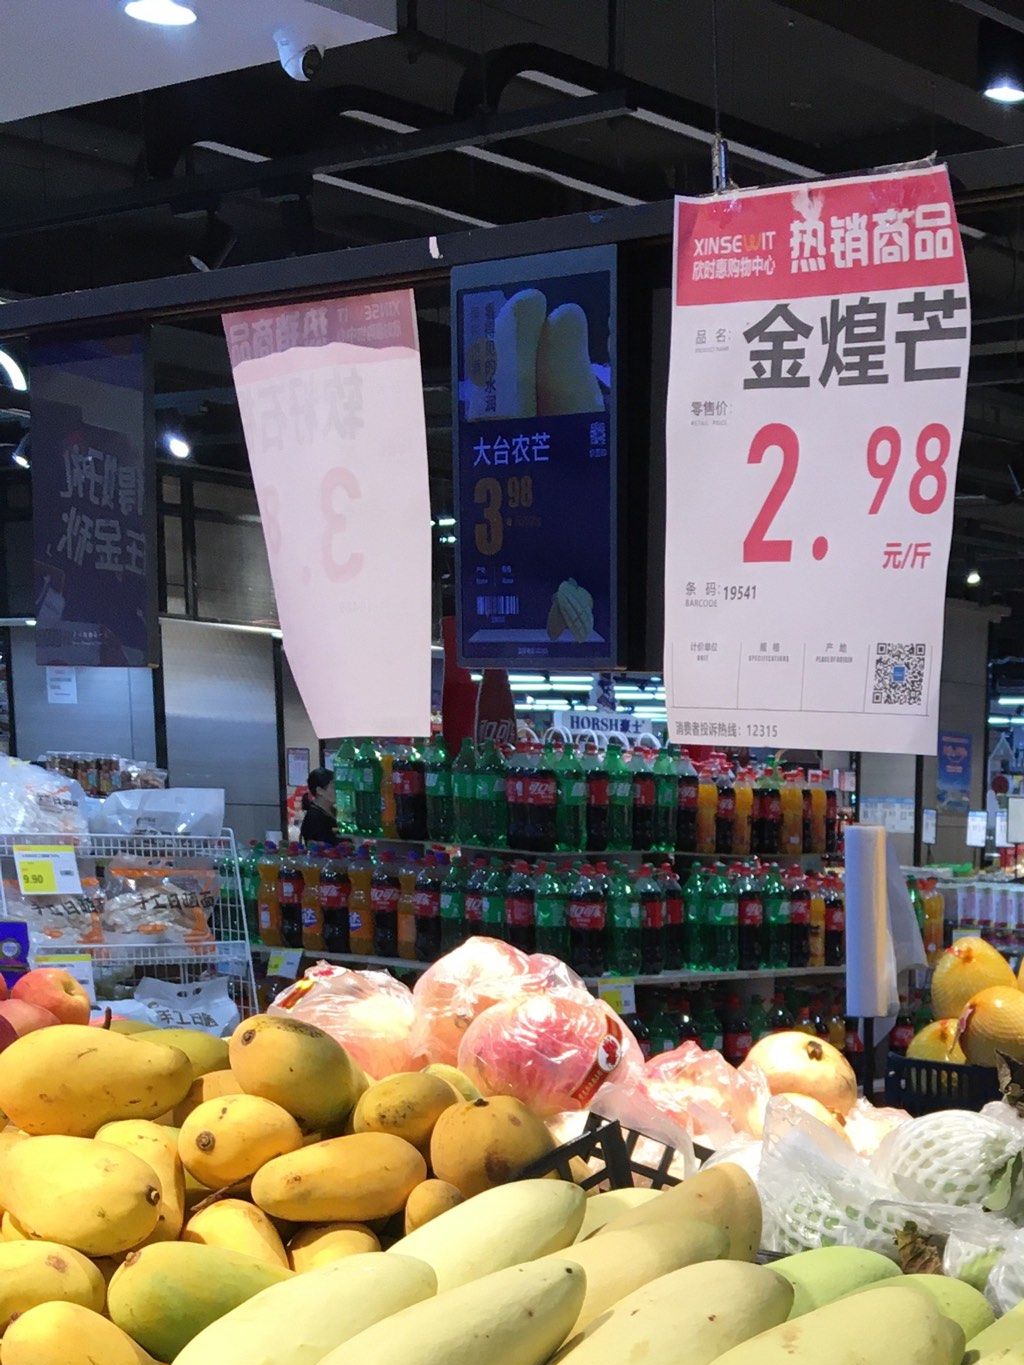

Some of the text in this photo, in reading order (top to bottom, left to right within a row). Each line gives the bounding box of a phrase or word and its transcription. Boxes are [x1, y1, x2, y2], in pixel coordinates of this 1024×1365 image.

[789, 202, 954, 274] 热销商品
[742, 289, 967, 390] 金煌芒
[473, 432, 551, 467] 大台农芒
[882, 542, 932, 569] 元/斤
[723, 585, 757, 600] 19541
[685, 599, 718, 608] BARCODE
[746, 724, 778, 738] 12315
[23, 874, 43, 884] 9.90
